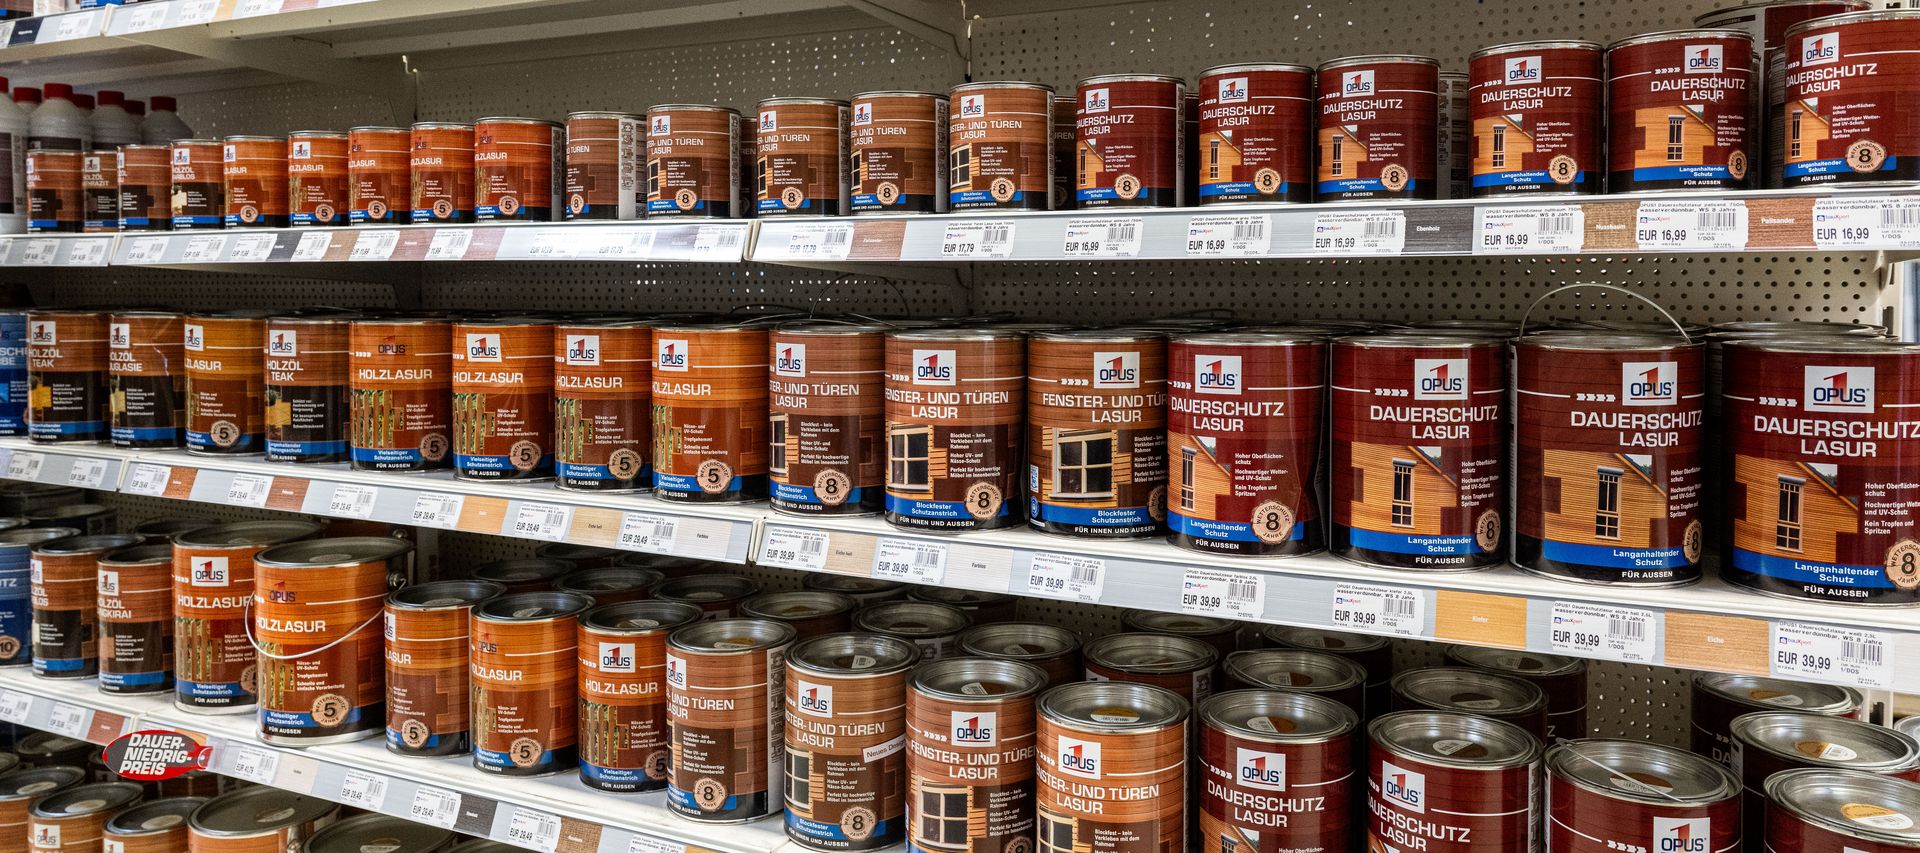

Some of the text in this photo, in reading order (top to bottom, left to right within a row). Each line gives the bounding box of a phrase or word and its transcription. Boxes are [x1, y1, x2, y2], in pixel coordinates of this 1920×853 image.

[1786, 63, 1877, 88] DAUERSCHUTZ
[1651, 78, 1745, 92] DAUERSCHUTZ
[1800, 80, 1840, 95] LASUR
[1482, 87, 1571, 103] DAUERSCHUTZ
[1683, 90, 1724, 101] LASUR
[1324, 99, 1403, 114] DAUERSCHUTZ
[1504, 100, 1543, 110] LASUR
[1203, 105, 1275, 120] DAUERSCHUTZ
[1341, 111, 1376, 122] LASUR
[968, 119, 1022, 130] UND TÜREN
[1218, 117, 1249, 127] LASUR
[781, 132, 810, 142] TÜREN
[859, 126, 906, 136] UND TÜREN
[960, 131, 986, 139] LASUR
[1085, 126, 1110, 135] LASUR
[675, 138, 704, 146] TÜREN
[1859, 149, 1871, 163] 8
[1559, 162, 1568, 175] 8
[1797, 160, 1842, 169] Langanhaltender
[1263, 175, 1272, 187] 8
[1390, 171, 1399, 183] 8
[998, 183, 1006, 194] 8
[1123, 180, 1130, 191] 8
[682, 194, 689, 203] 8
[505, 201, 511, 210] 5
[1485, 234, 1528, 246] EUR 16,99
[1639, 230, 1687, 243] EUR 16,99
[1817, 228, 1869, 241] EUR 16,99
[944, 244, 974, 253] EUR 17,79
[1187, 241, 1225, 250] EUR 16,99
[1315, 238, 1355, 249] EUR 16,99
[266, 359, 304, 371] HOLZÖL
[271, 371, 294, 381] TEAK
[359, 369, 433, 380] HOLZLASUR
[453, 372, 524, 383] HOLZLASUR
[917, 366, 950, 378] OPUS
[1099, 368, 1135, 380] OPUS
[557, 375, 623, 388] HOLZLASUR
[1200, 373, 1235, 387] OPUS
[1422, 378, 1462, 391] OPUS
[784, 382, 860, 395] UND TÜREN
[1630, 382, 1672, 396] OPUS
[1813, 388, 1866, 402] OPUS
[775, 395, 807, 408] LASUR
[885, 390, 1009, 404] FENSTER- UND TÜREN
[1042, 393, 1144, 408] FENSTER- UND
[911, 406, 958, 419] LASUR
[1171, 397, 1284, 417] DAUERSCHUTZ
[1370, 405, 1498, 422] DAUERSCHUTZ
[1091, 410, 1142, 423] LASUR
[1571, 410, 1702, 429] DAUERSCHUTZ
[1193, 416, 1244, 432] LASUR
[1754, 416, 1920, 439] DAUERSCHUTZ
[1412, 425, 1470, 439] LASUR
[1619, 432, 1679, 447] LASUR
[520, 448, 531, 461] 5
[1801, 439, 1877, 457] LASUR
[707, 468, 719, 483] 5
[900, 516, 910, 524] FÜR
[1265, 512, 1280, 531] 8
[622, 534, 634, 543] EUR
[1415, 556, 1432, 564] FÜR
[1613, 550, 1679, 559] Langanhaltender
[878, 561, 909, 573] EUR 39,99
[1795, 562, 1879, 575] Langanhaltender
[1030, 575, 1064, 589] EUR 39,99
[1819, 574, 1854, 583] Schutz
[1804, 585, 1868, 597] FÜR AUSSEN
[177, 594, 255, 608] HOLZLASUR
[1183, 594, 1221, 608] EUR 39,99
[1553, 631, 1600, 647] EUR 39,99
[1778, 651, 1830, 670] EUR 39,99
[585, 679, 658, 695] HOLZLASUR
[809, 721, 885, 736] UND TÜREN
[957, 728, 990, 739] OPUS
[128, 734, 185, 748] DAUER-
[796, 731, 834, 749] LASUR
[124, 746, 192, 762] NIEDRIG-
[520, 746, 530, 758] 5
[866, 747, 887, 758] Neues
[911, 740, 1000, 766] FENSTER- UND
[119, 761, 166, 776] PREIS
[1062, 753, 1095, 771] OPUS
[949, 765, 998, 779] LASUR
[1242, 766, 1280, 783] OPUS
[1072, 783, 1159, 801] UND TÜREN
[1208, 779, 1325, 813] DAUERSCHUTZ
[1056, 793, 1103, 814] LASUR
[1234, 807, 1288, 827] LASUR
[1380, 821, 1427, 852] LASUR
